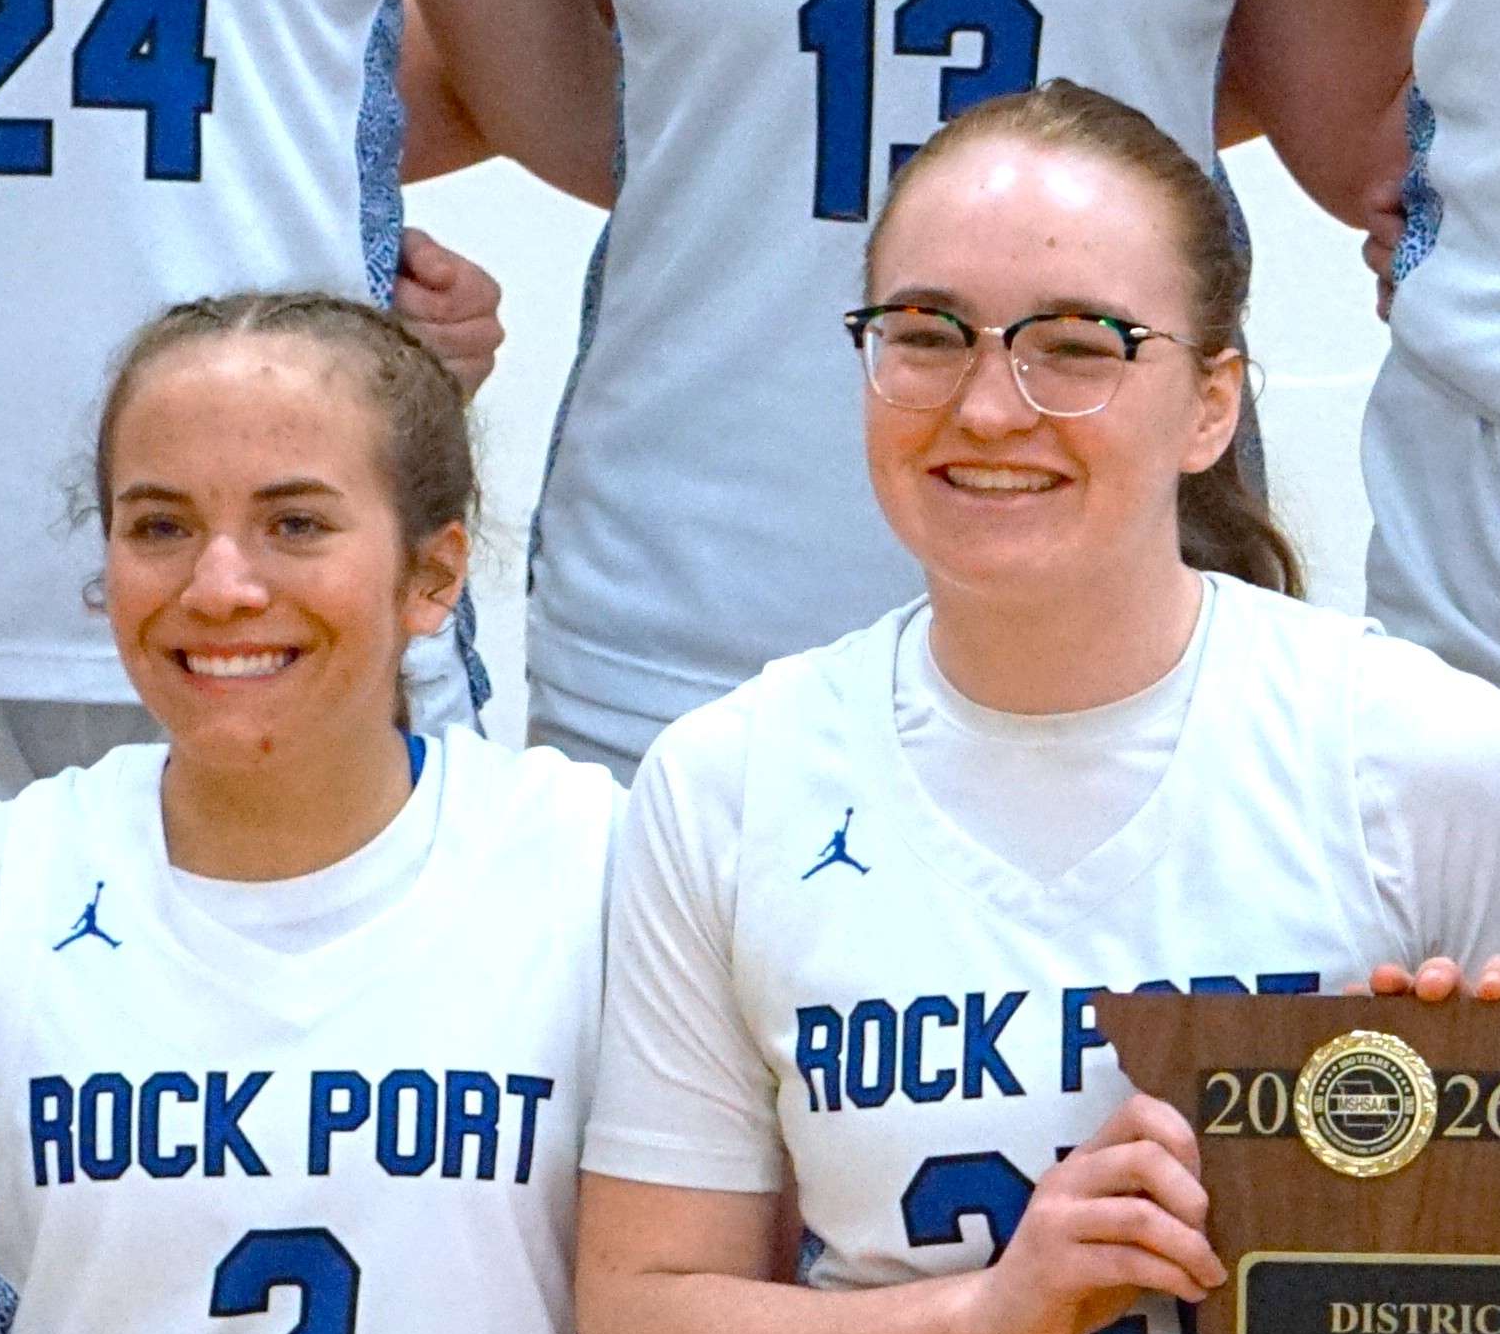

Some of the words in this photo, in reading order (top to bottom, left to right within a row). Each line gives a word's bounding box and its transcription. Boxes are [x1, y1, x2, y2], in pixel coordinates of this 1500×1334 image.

[795, 989, 1030, 1113] ROCK
[29, 1071, 275, 1187] ROCK
[307, 1068, 555, 1185] PORT
[1204, 1071, 1289, 1135] 20
[1338, 1096, 1389, 1112] MSHSAA
